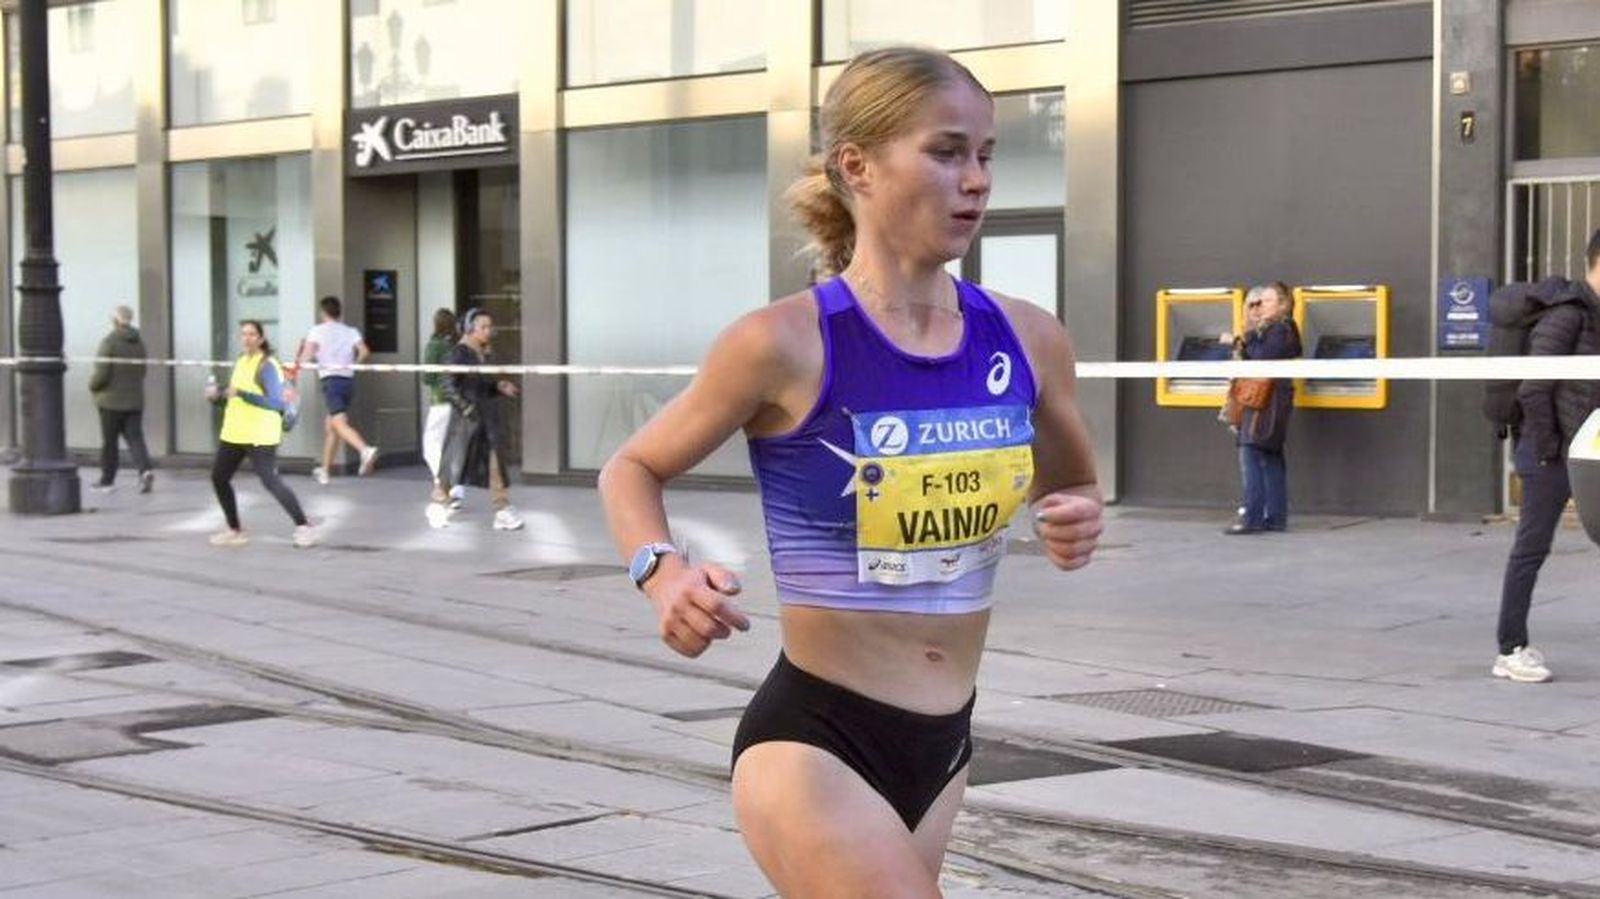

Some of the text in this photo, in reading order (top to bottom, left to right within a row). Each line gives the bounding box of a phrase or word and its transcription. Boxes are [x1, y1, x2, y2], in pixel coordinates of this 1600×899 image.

[395, 111, 504, 150] CaixaBank
[1462, 117, 1472, 135] 7
[920, 419, 1011, 444] ZURICH
[922, 471, 980, 496] F-103
[898, 503, 998, 544] VAINIO
